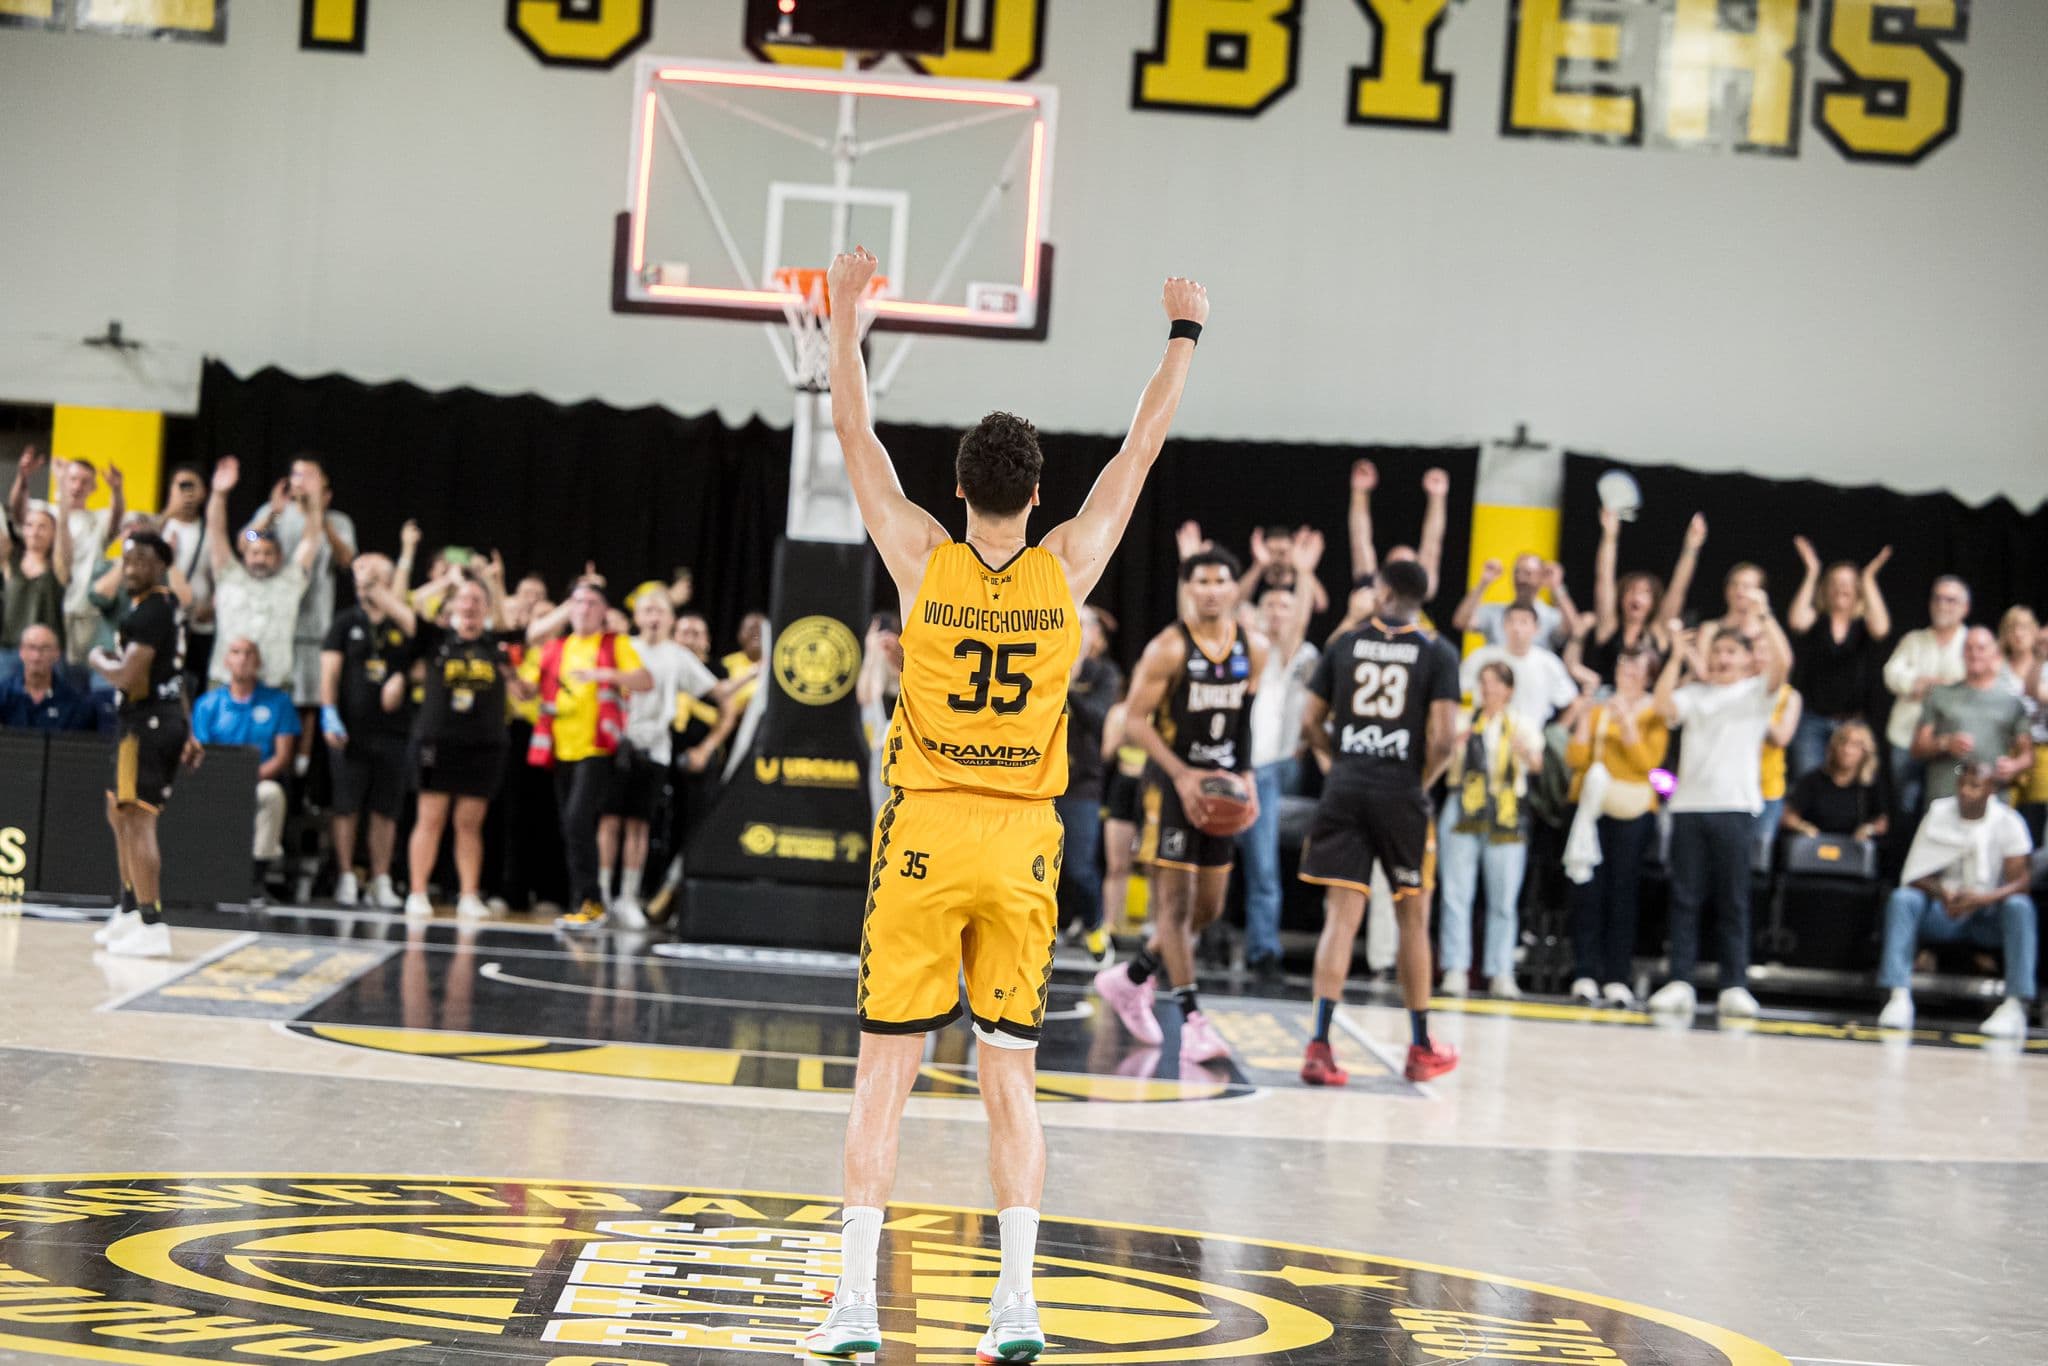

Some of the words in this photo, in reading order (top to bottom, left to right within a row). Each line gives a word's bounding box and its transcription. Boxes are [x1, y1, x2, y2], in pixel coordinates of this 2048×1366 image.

[924, 600, 1064, 633] WOJCIECHOWSKI
[947, 639, 1036, 716] 35
[1353, 662, 1409, 719] 23
[940, 742, 1042, 759] RAMPA
[900, 849, 930, 880] 35
[1389, 1308, 1627, 1366] 1972
